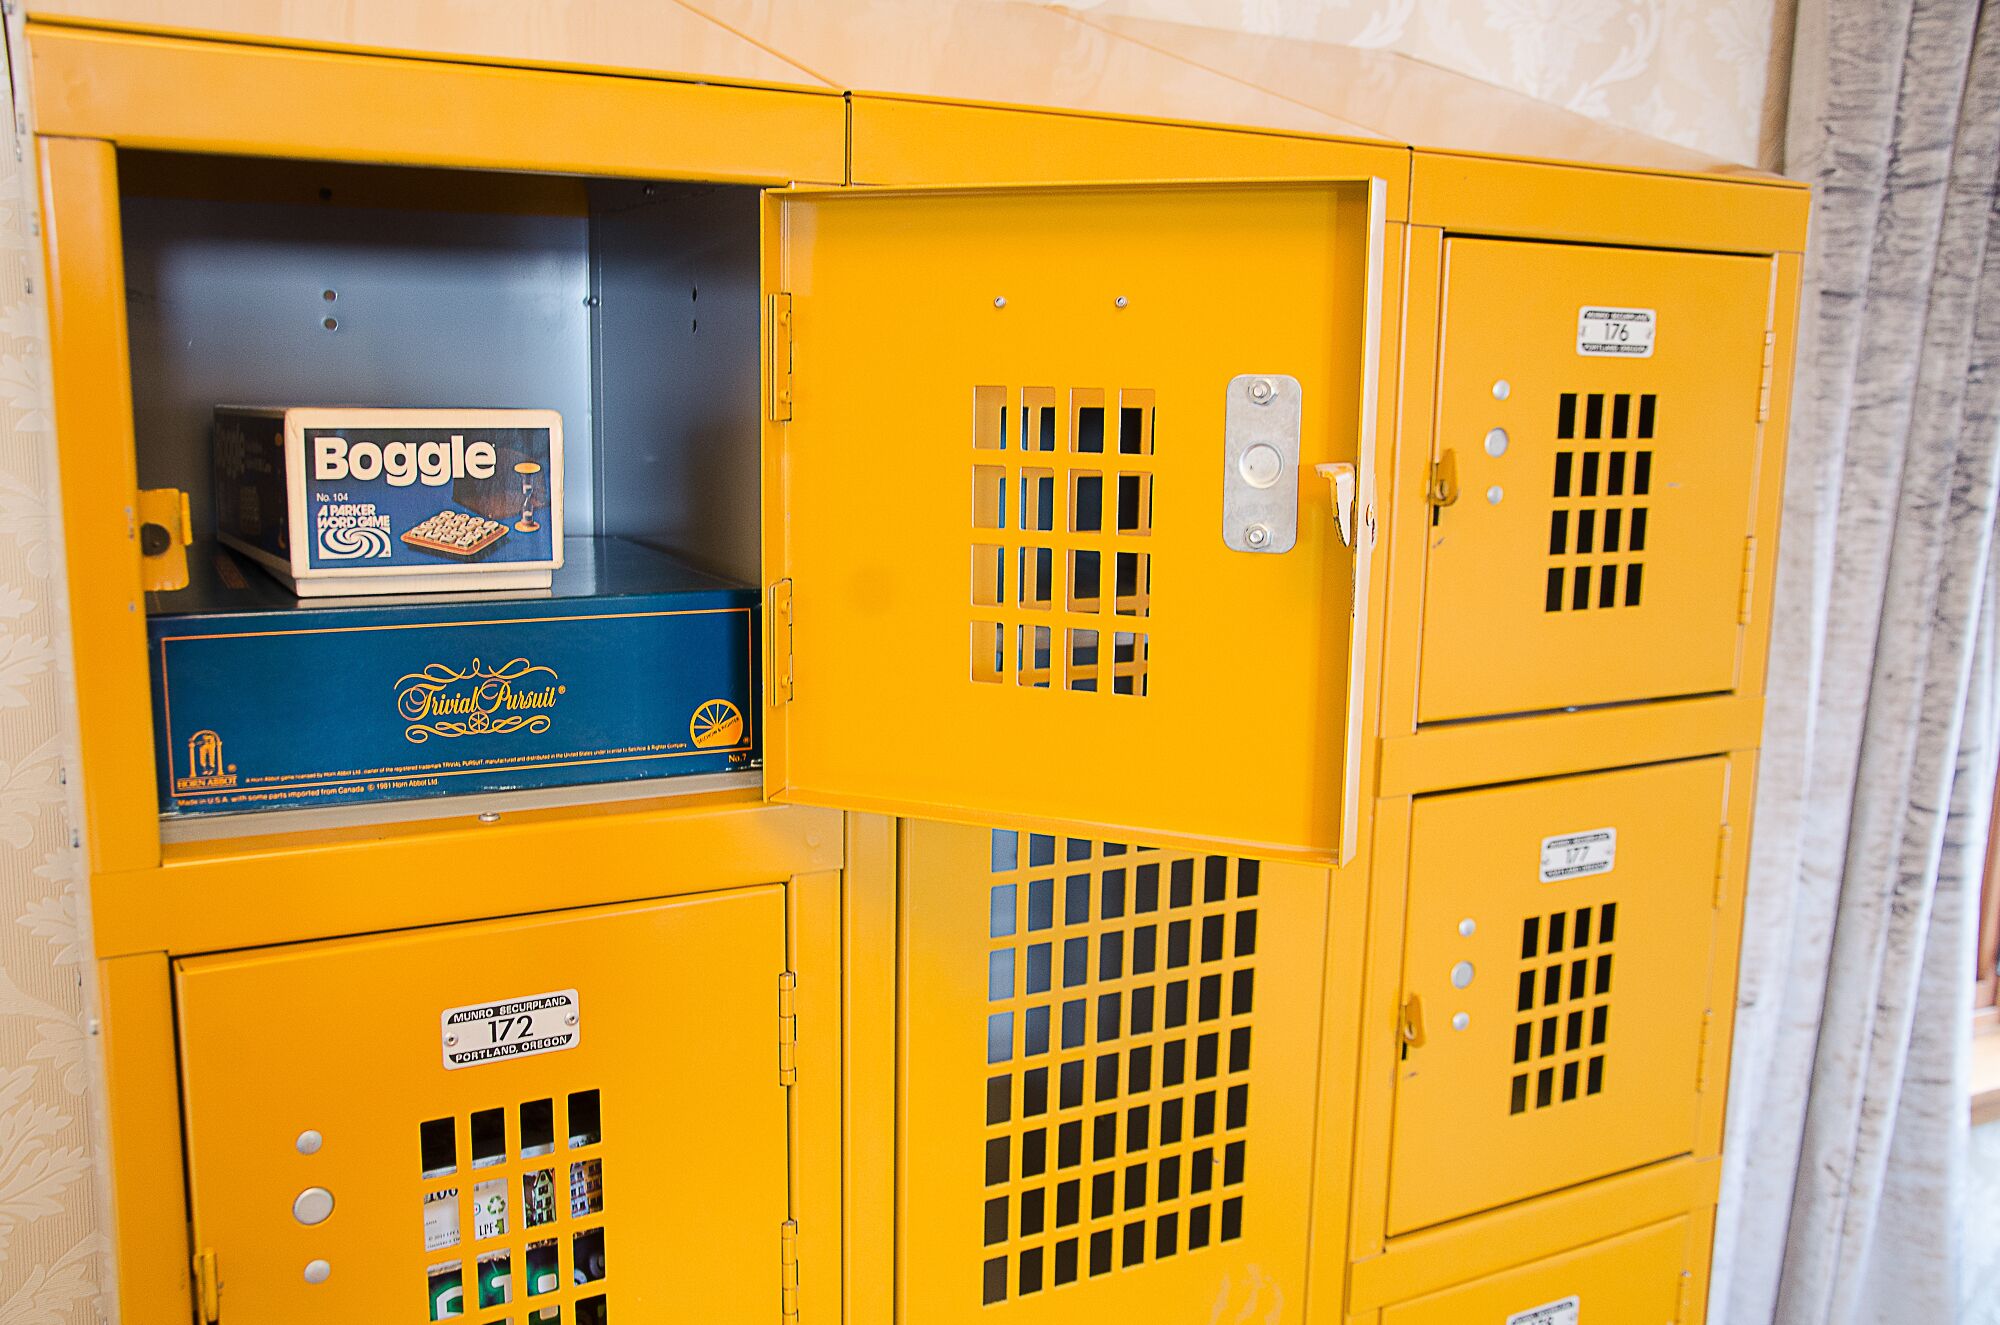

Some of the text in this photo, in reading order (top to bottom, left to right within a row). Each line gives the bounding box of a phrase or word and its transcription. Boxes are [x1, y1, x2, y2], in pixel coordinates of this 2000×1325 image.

[1605, 322, 1629, 341] 176
[314, 435, 497, 487] Boggle
[333, 492, 348, 502] 104
[317, 503, 376, 516] A PARKER
[317, 515, 390, 529] WORD GAME
[398, 677, 557, 722] Trivial Pursuit
[177, 776, 238, 789] HORN ABBOT
[288, 790, 320, 798] imported
[377, 782, 391, 790] 1981
[409, 779, 427, 787] Abbot
[453, 996, 567, 1023] MUNRO SECURPLAND
[487, 1015, 534, 1043] 172
[455, 1035, 567, 1063] PORTLAND, OREGON
